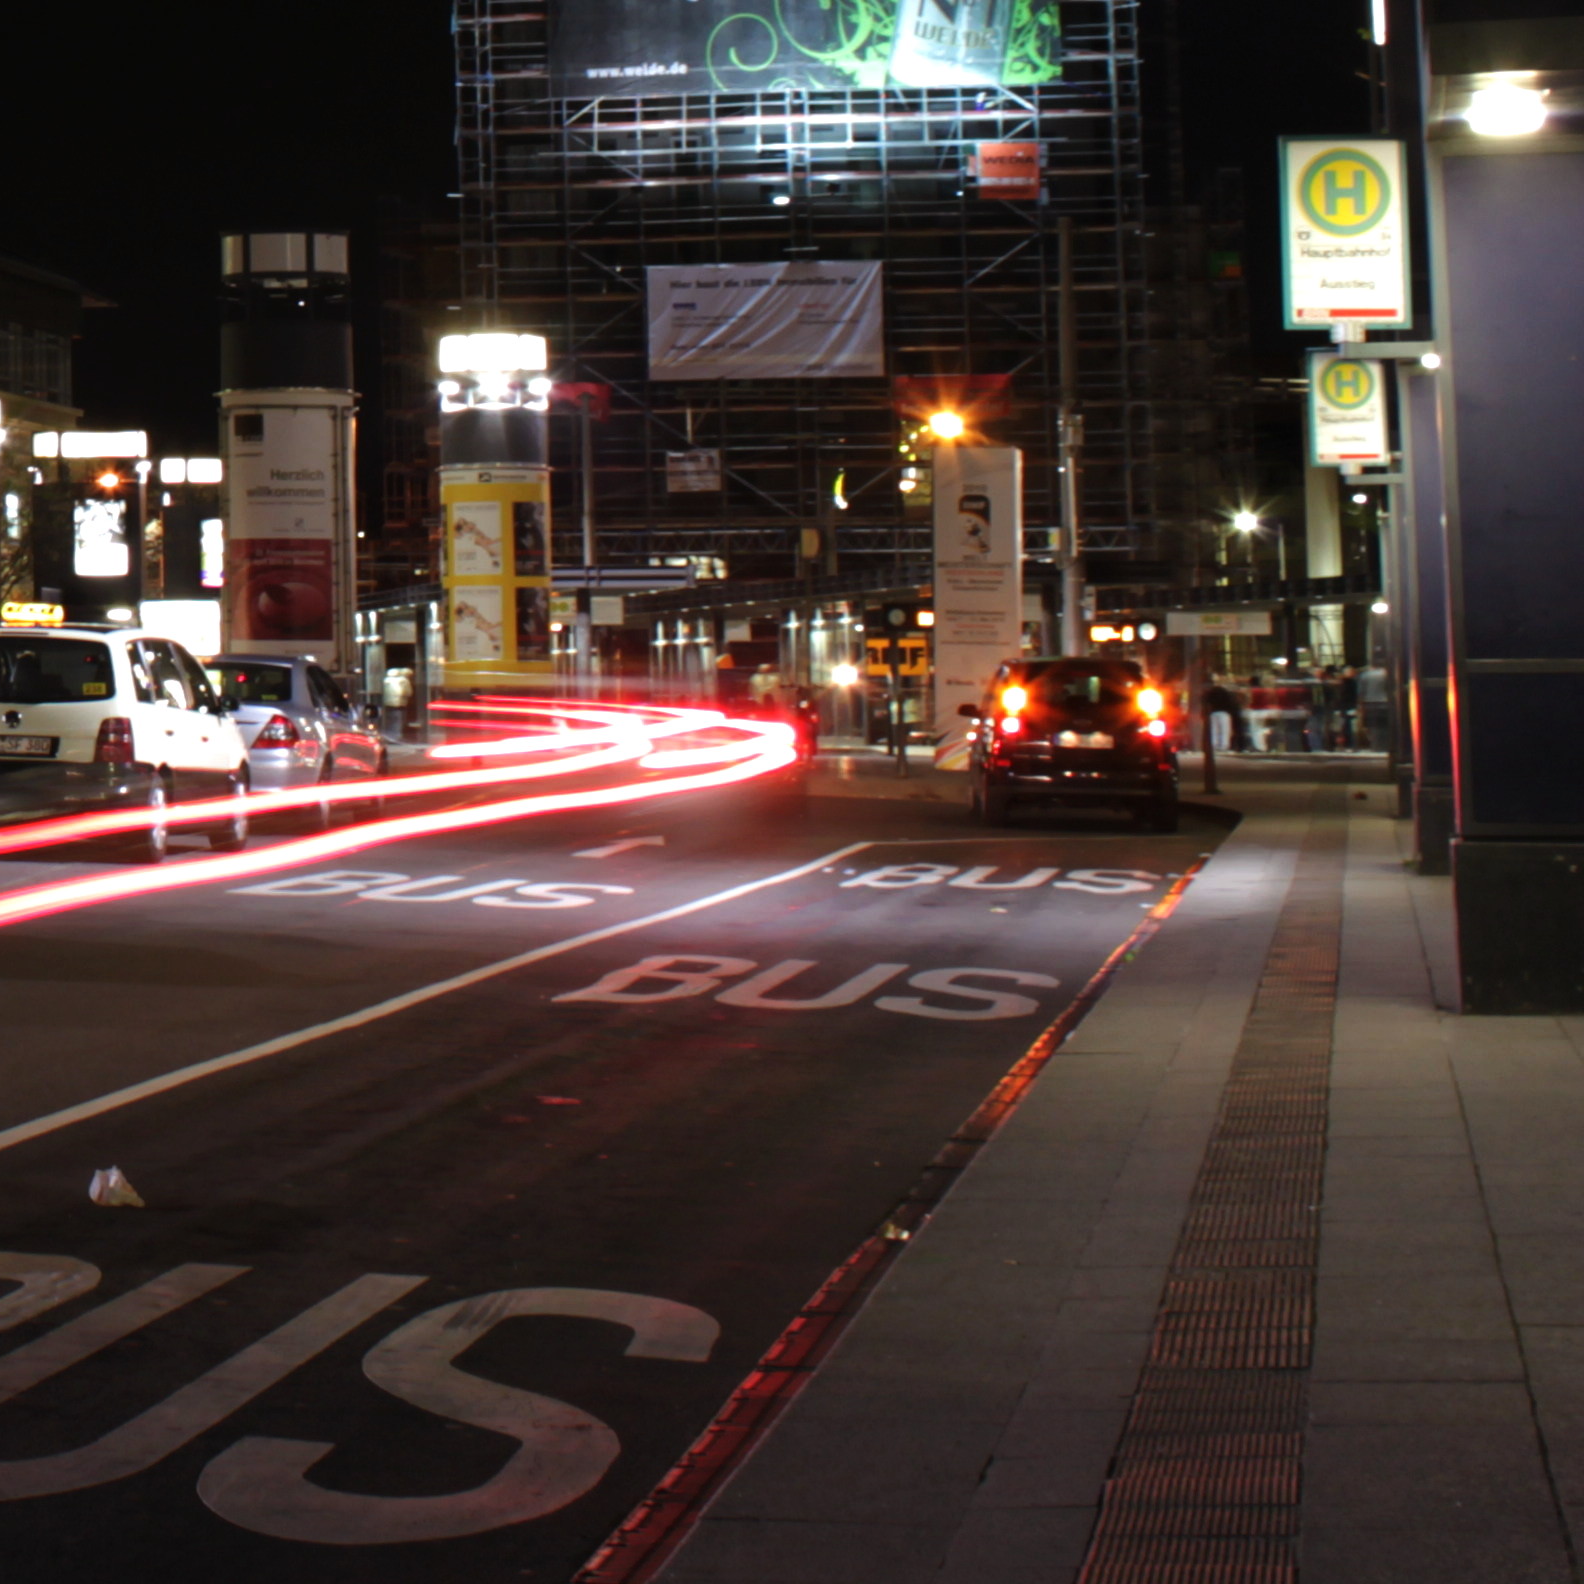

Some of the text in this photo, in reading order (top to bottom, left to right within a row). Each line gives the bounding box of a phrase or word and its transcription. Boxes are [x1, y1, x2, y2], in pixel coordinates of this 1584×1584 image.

[1322, 169, 1367, 217] H
[1334, 370, 1361, 398] H
[270, 469, 325, 482] Herzlich
[246, 486, 326, 499] willkommen
[224, 870, 634, 909] BUS
[839, 862, 1156, 894] BUS
[550, 954, 1062, 1020] BUS
